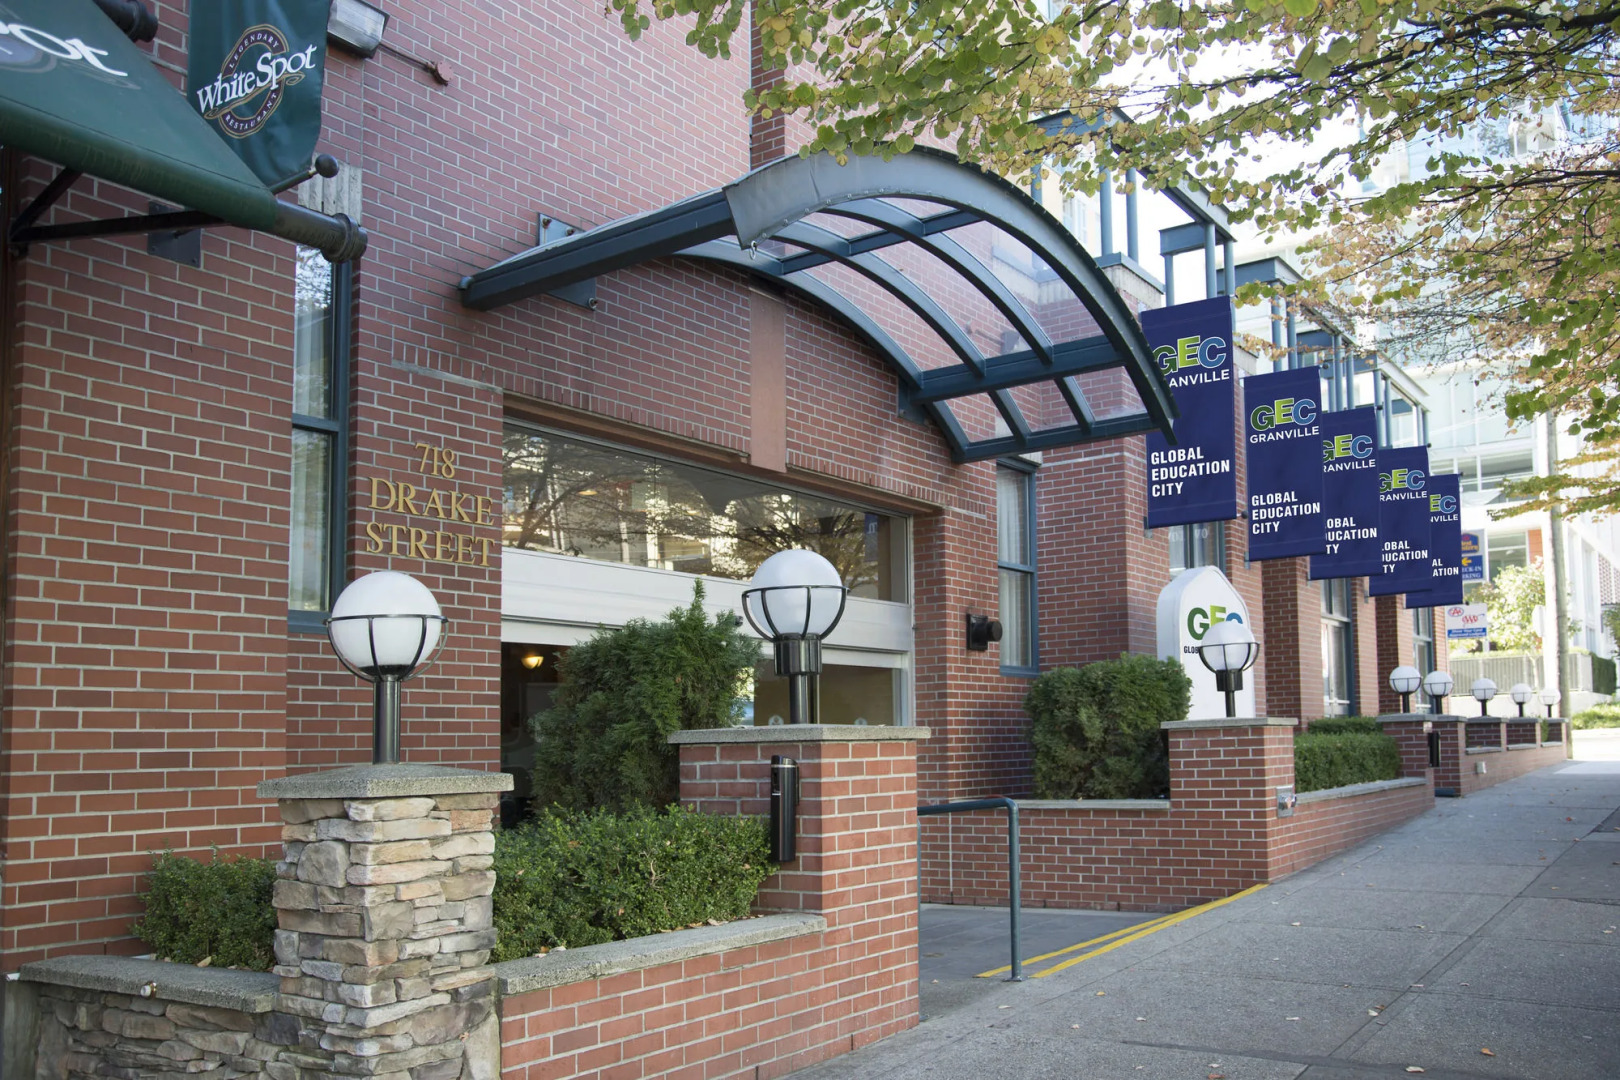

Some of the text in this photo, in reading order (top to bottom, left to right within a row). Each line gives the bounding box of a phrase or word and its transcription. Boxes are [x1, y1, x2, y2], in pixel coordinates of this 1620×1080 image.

[229, 32, 280, 69] LEGENDARY
[225, 92, 277, 130] RESTAURANT
[1153, 335, 1227, 376] GEC
[1169, 369, 1230, 388] ANVILLE
[1250, 398, 1317, 432] GEC
[1250, 426, 1320, 444] GRANVILLE
[1151, 446, 1204, 465] GLOBAL
[1323, 433, 1374, 463] GEC
[415, 442, 456, 479] 718
[1323, 459, 1376, 473] ANVILLE
[1151, 459, 1231, 481] EDUCATION
[1152, 481, 1184, 498] CITY
[1379, 468, 1426, 494] GEC
[368, 477, 495, 526] DRAKE
[1251, 491, 1298, 507] GLOBAL
[1380, 490, 1428, 502] RANVILLE
[1429, 493, 1457, 514] EC
[1252, 502, 1321, 521] EDUCATION
[1252, 521, 1280, 535] CITY
[1326, 517, 1356, 529] OBAL
[366, 521, 496, 567] STREET
[1326, 528, 1377, 542] UCATION
[1326, 543, 1340, 554] TY
[1382, 540, 1410, 552] OBAL
[1382, 550, 1428, 563] UCATION
[1383, 564, 1396, 574] TY
[1432, 566, 1459, 578] ATION
[1183, 646, 1200, 654] GLOB
